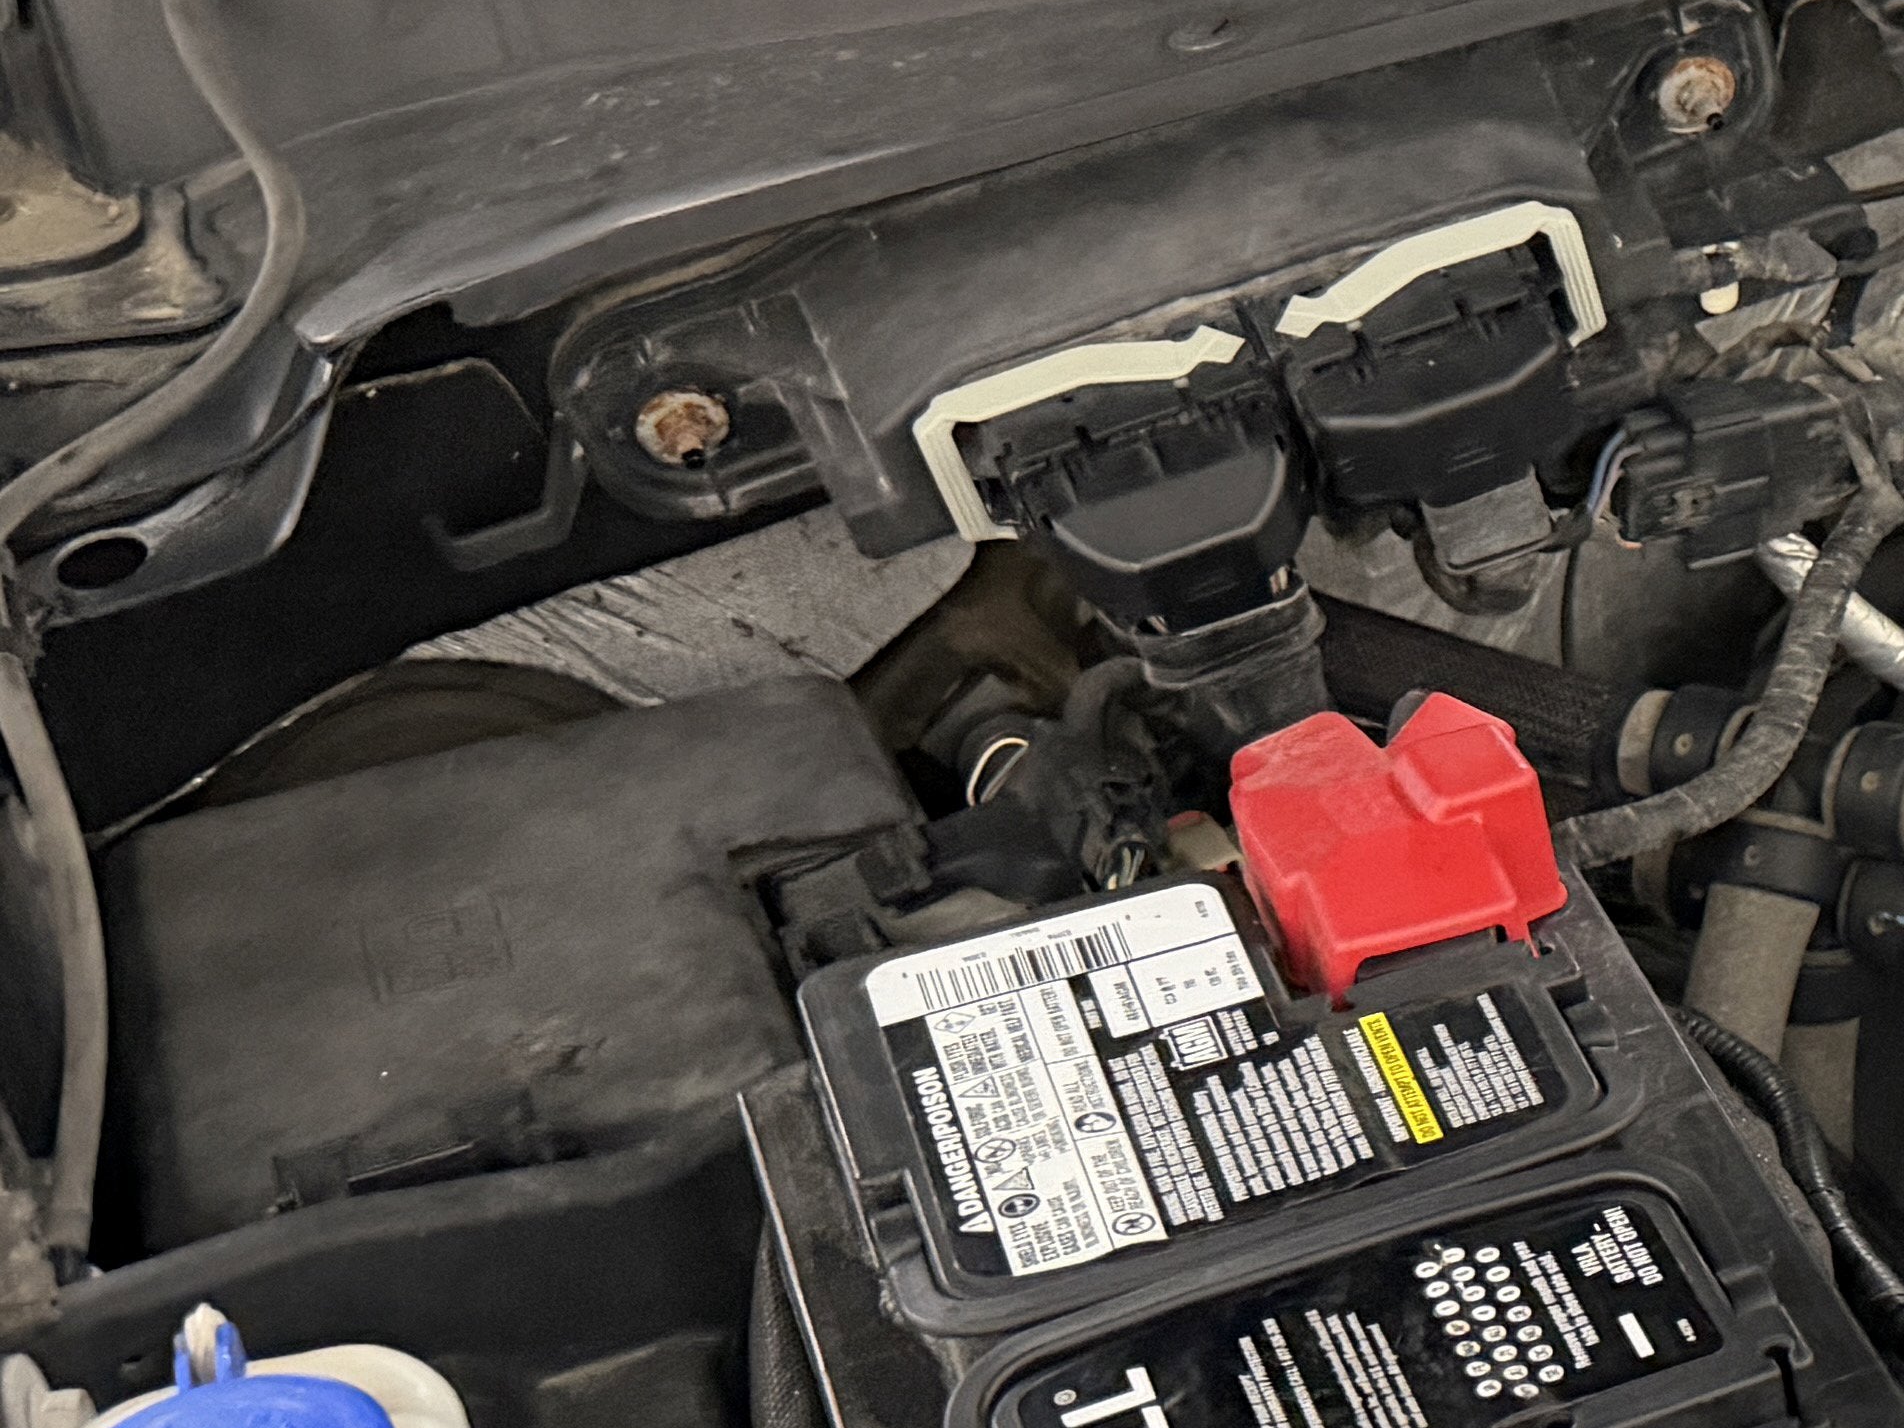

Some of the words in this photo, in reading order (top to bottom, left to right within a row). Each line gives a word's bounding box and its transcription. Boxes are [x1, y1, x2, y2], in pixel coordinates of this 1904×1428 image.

[1172, 1021, 1220, 1063] AGM
[1376, 1042, 1400, 1063] OPEN
[1387, 1063, 1406, 1075] TO
[1392, 1075, 1422, 1109] ATTEMPT
[1409, 1108, 1430, 1125] NOT
[1419, 1124, 1436, 1138] DO
[913, 1067, 988, 1218] DANGER/POISON
[1601, 1204, 1639, 1244] OPEN!
[1570, 1241, 1604, 1277] VRLA
[1589, 1229, 1636, 1284] BATTERY
[1621, 1238, 1653, 1268] NOT
[1635, 1263, 1664, 1286] DO
